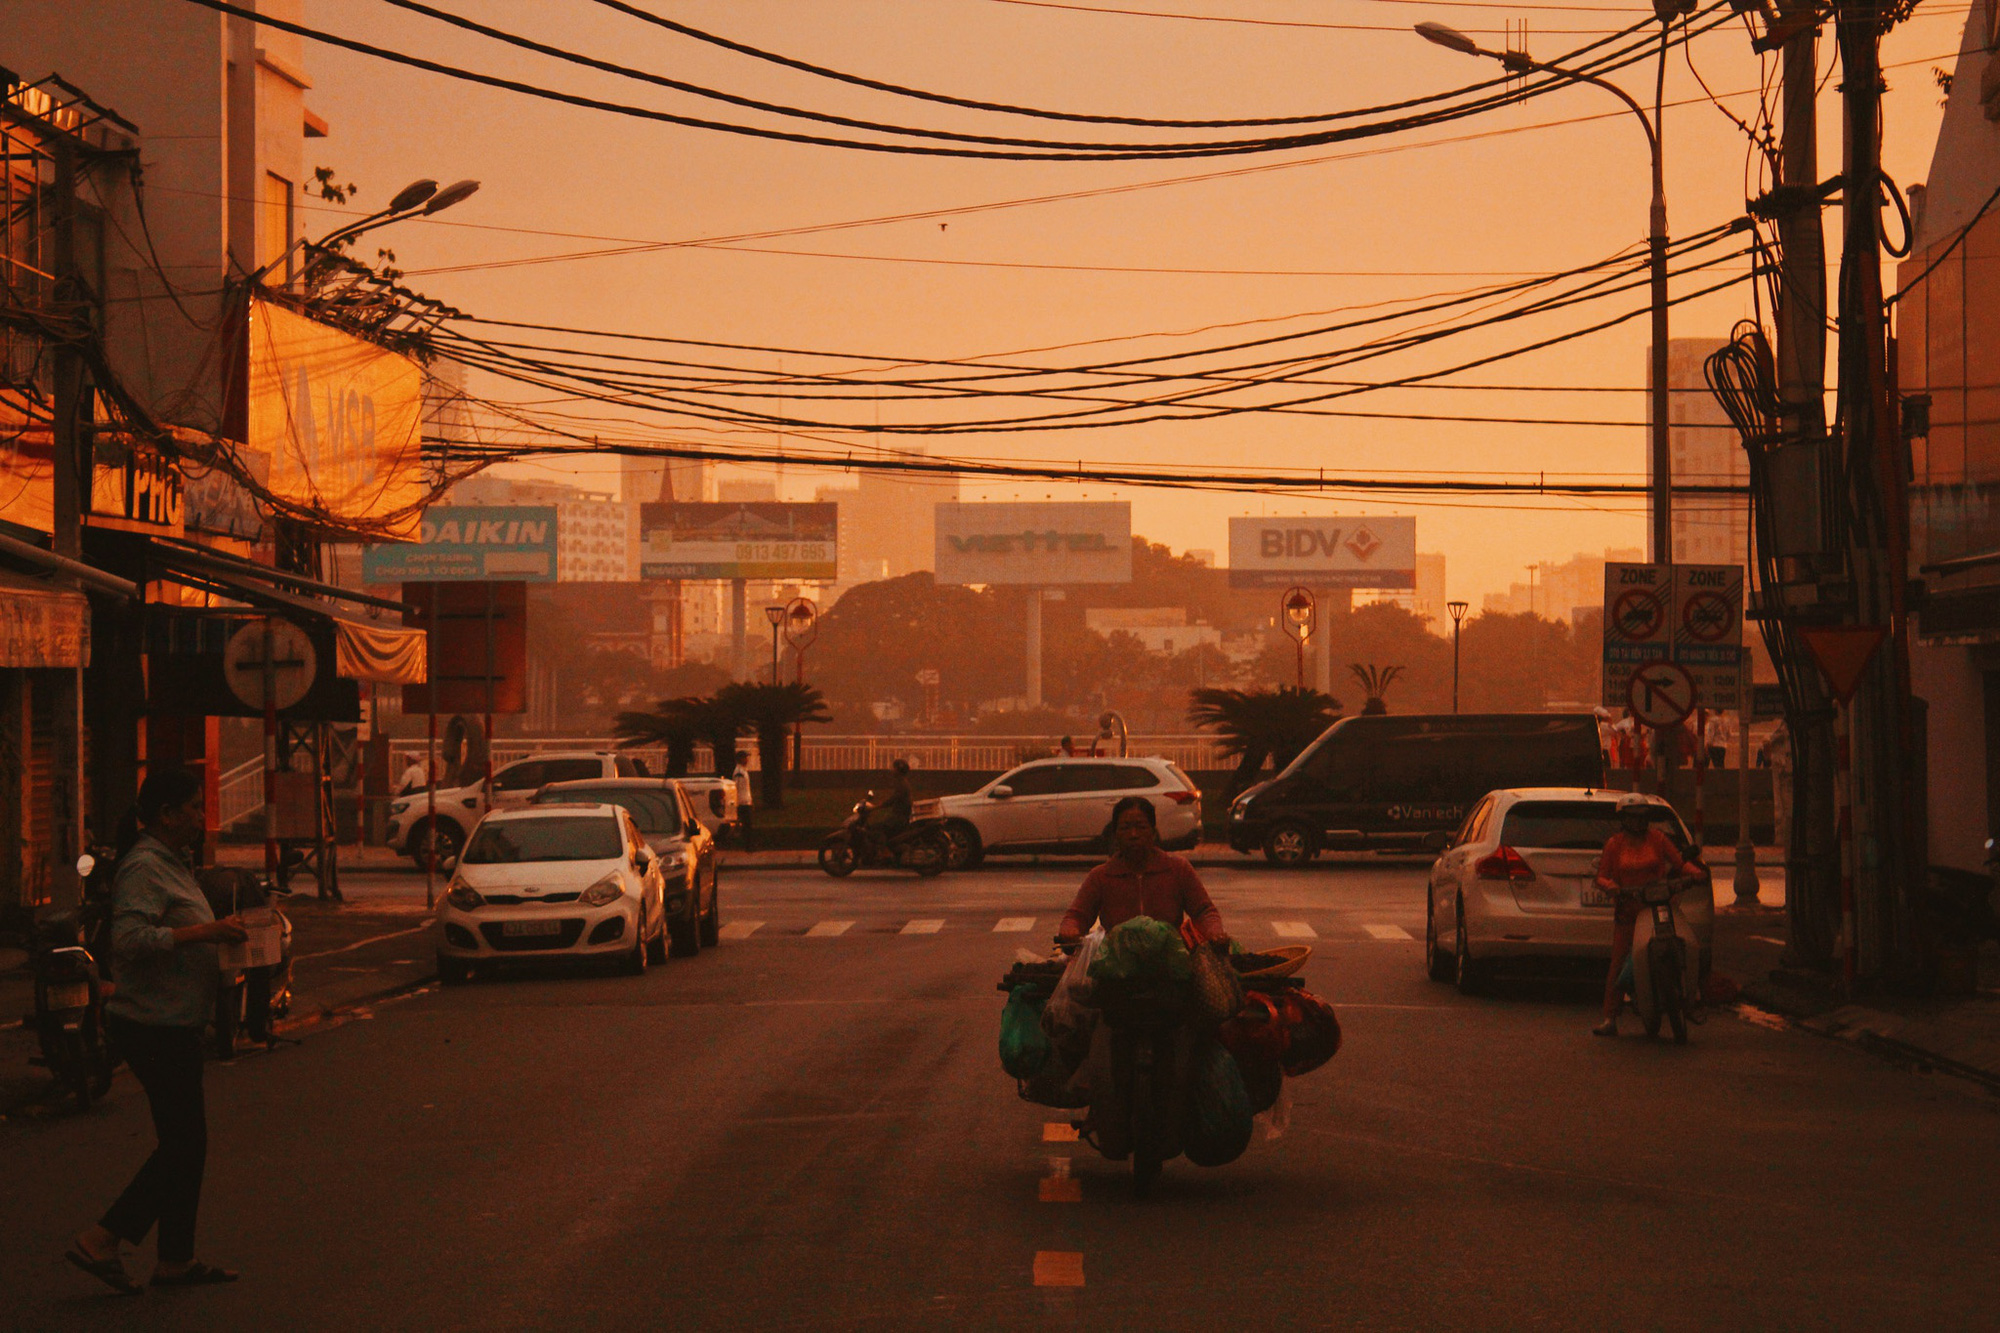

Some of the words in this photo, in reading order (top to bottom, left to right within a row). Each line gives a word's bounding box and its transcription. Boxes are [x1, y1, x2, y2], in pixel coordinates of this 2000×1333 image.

[1260, 528, 1341, 558] BIDV
[735, 544, 769, 560] 0913
[772, 544, 797, 560] 497
[801, 544, 826, 560] 695
[1620, 569, 1657, 584] ZONE
[1689, 570, 1726, 586] ZONE
